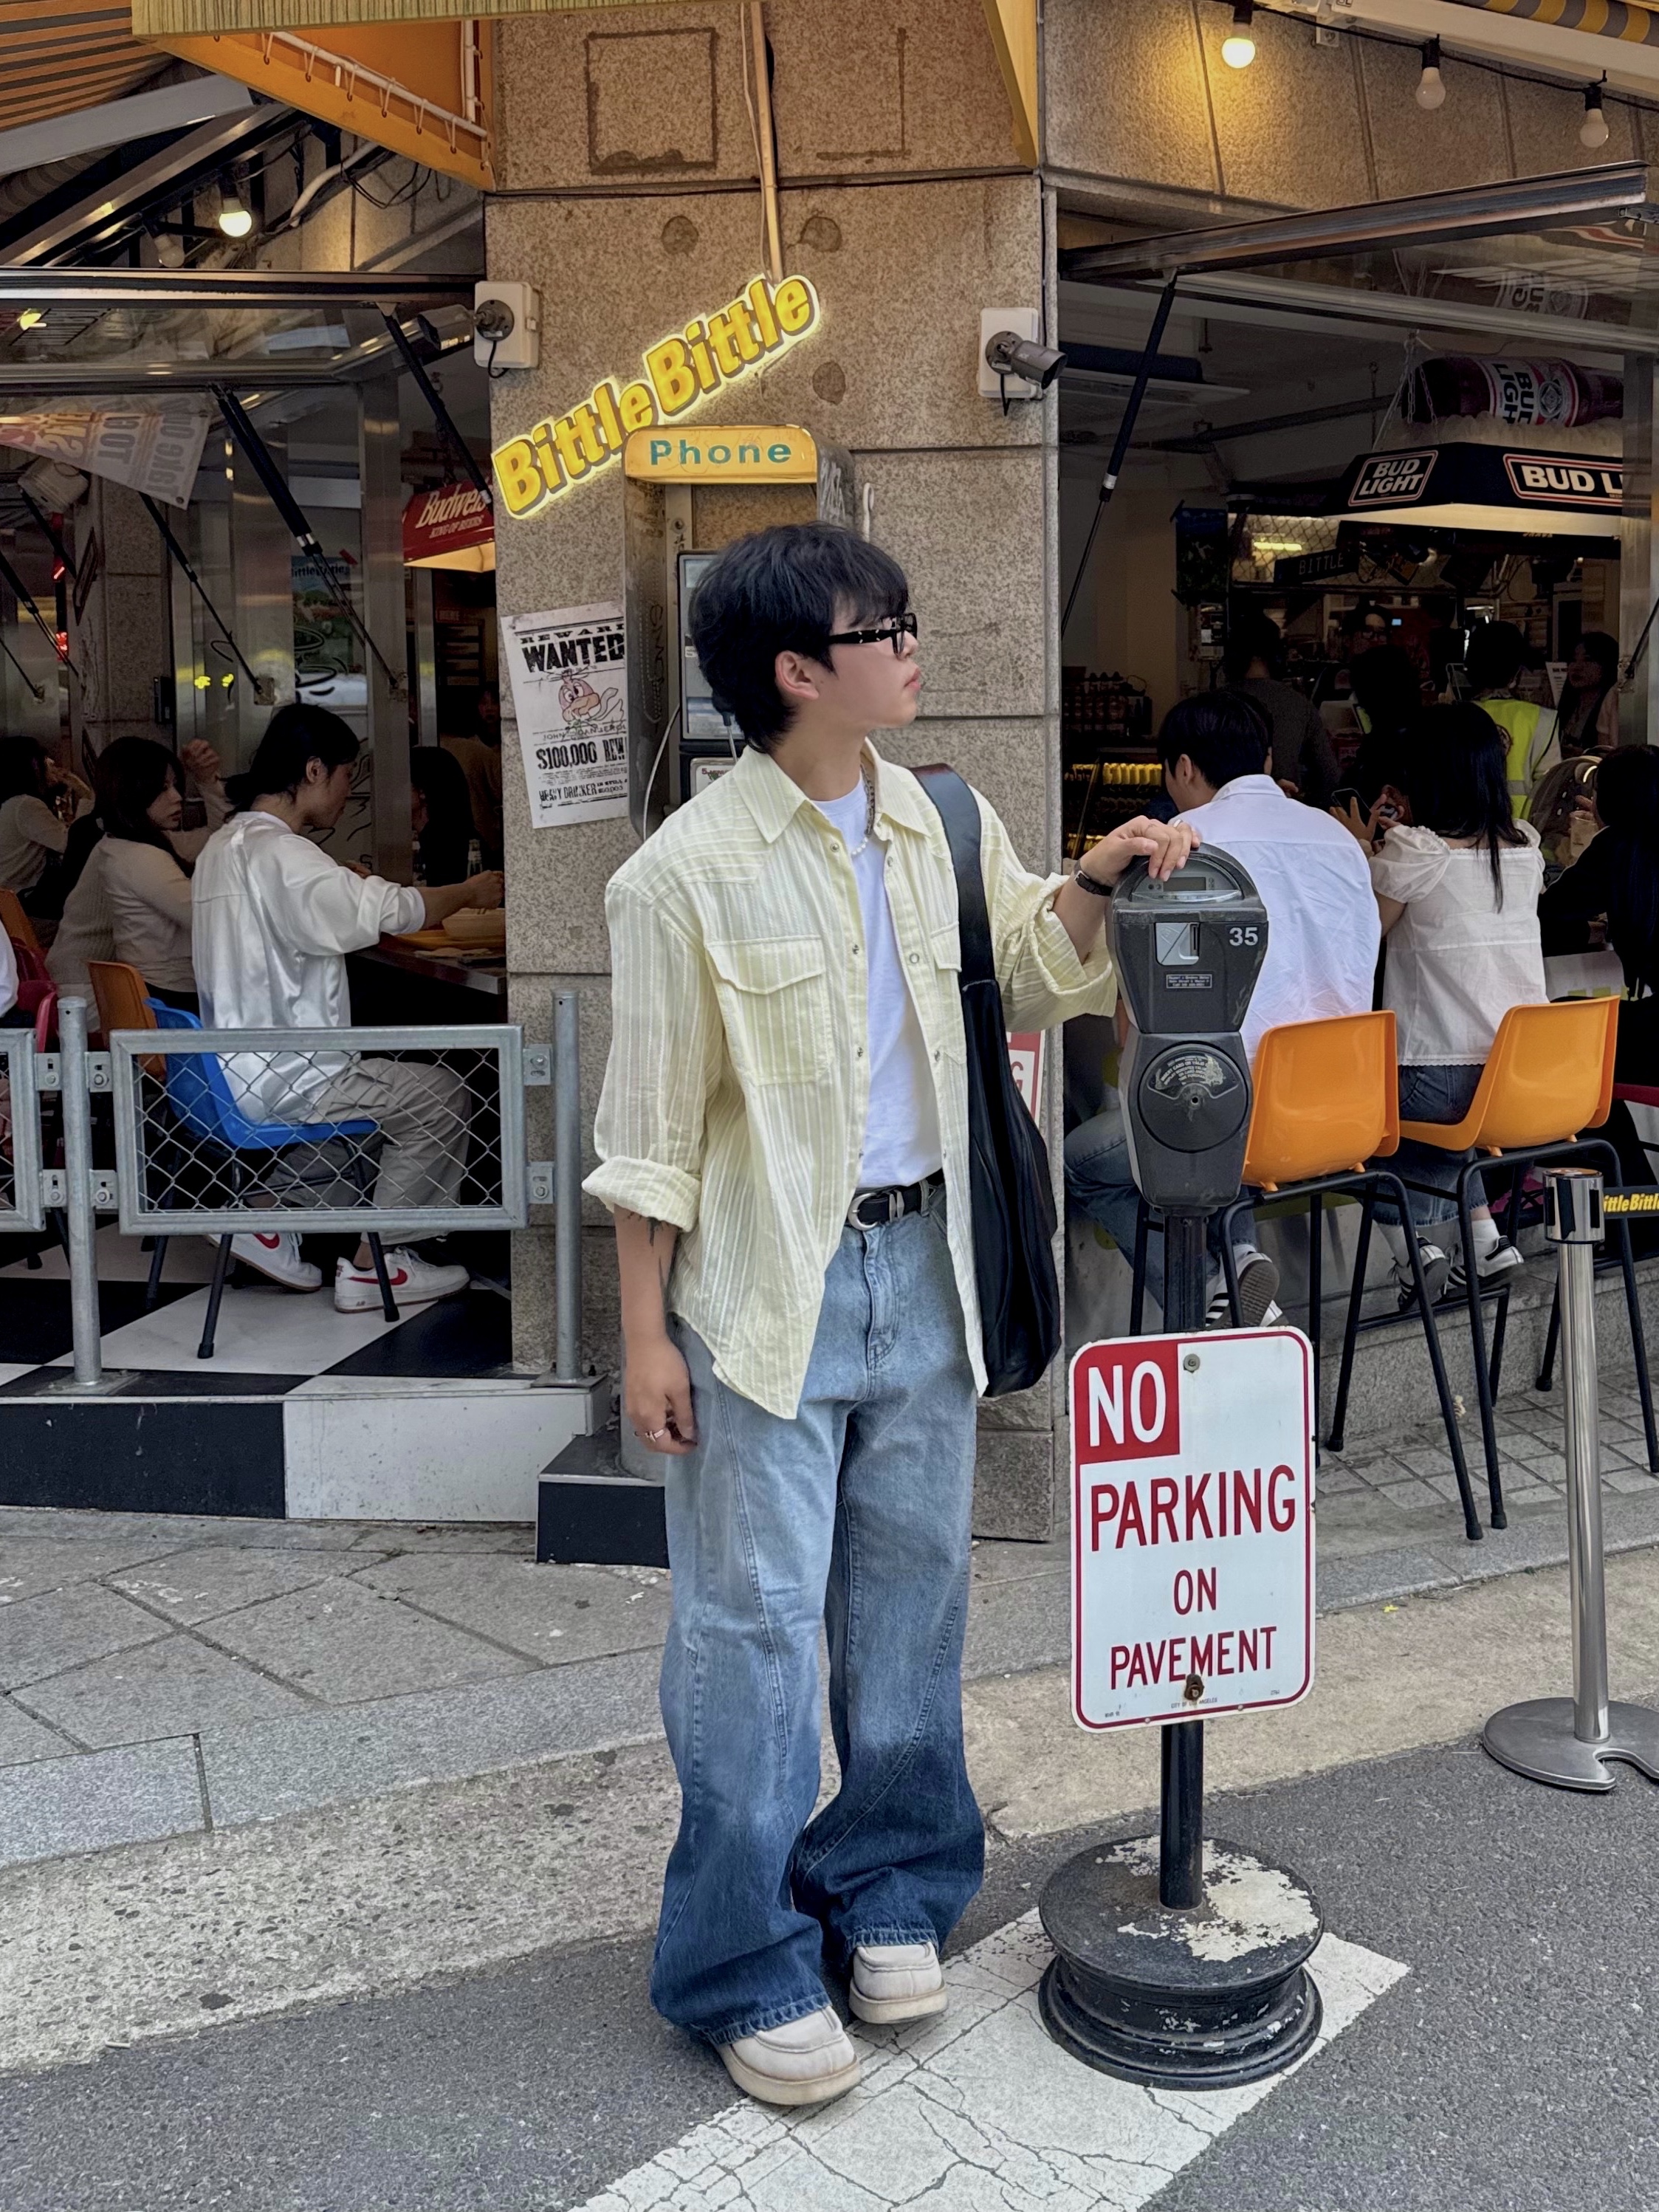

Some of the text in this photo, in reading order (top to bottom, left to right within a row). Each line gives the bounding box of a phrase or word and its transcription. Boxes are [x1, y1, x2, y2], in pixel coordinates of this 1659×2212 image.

[1491, 363, 1519, 424] LIGH
[649, 439, 792, 466] Phone
[1372, 458, 1421, 478] BUD
[1359, 473, 1424, 496] LIGHT
[1521, 464, 1623, 494] BUD L
[415, 484, 487, 529] Budweis
[1298, 552, 1344, 576] BITTLE
[522, 633, 625, 673] WANTED
[535, 736, 627, 769] $100,000 REW
[1229, 927, 1259, 947] 35
[1603, 1192, 1659, 1213] ittleBittl
[1088, 1361, 1167, 1447] NO
[1090, 1464, 1296, 1552] PARKING
[1174, 1567, 1217, 1615] ON
[1110, 1626, 1277, 1690] PAVEMENT
